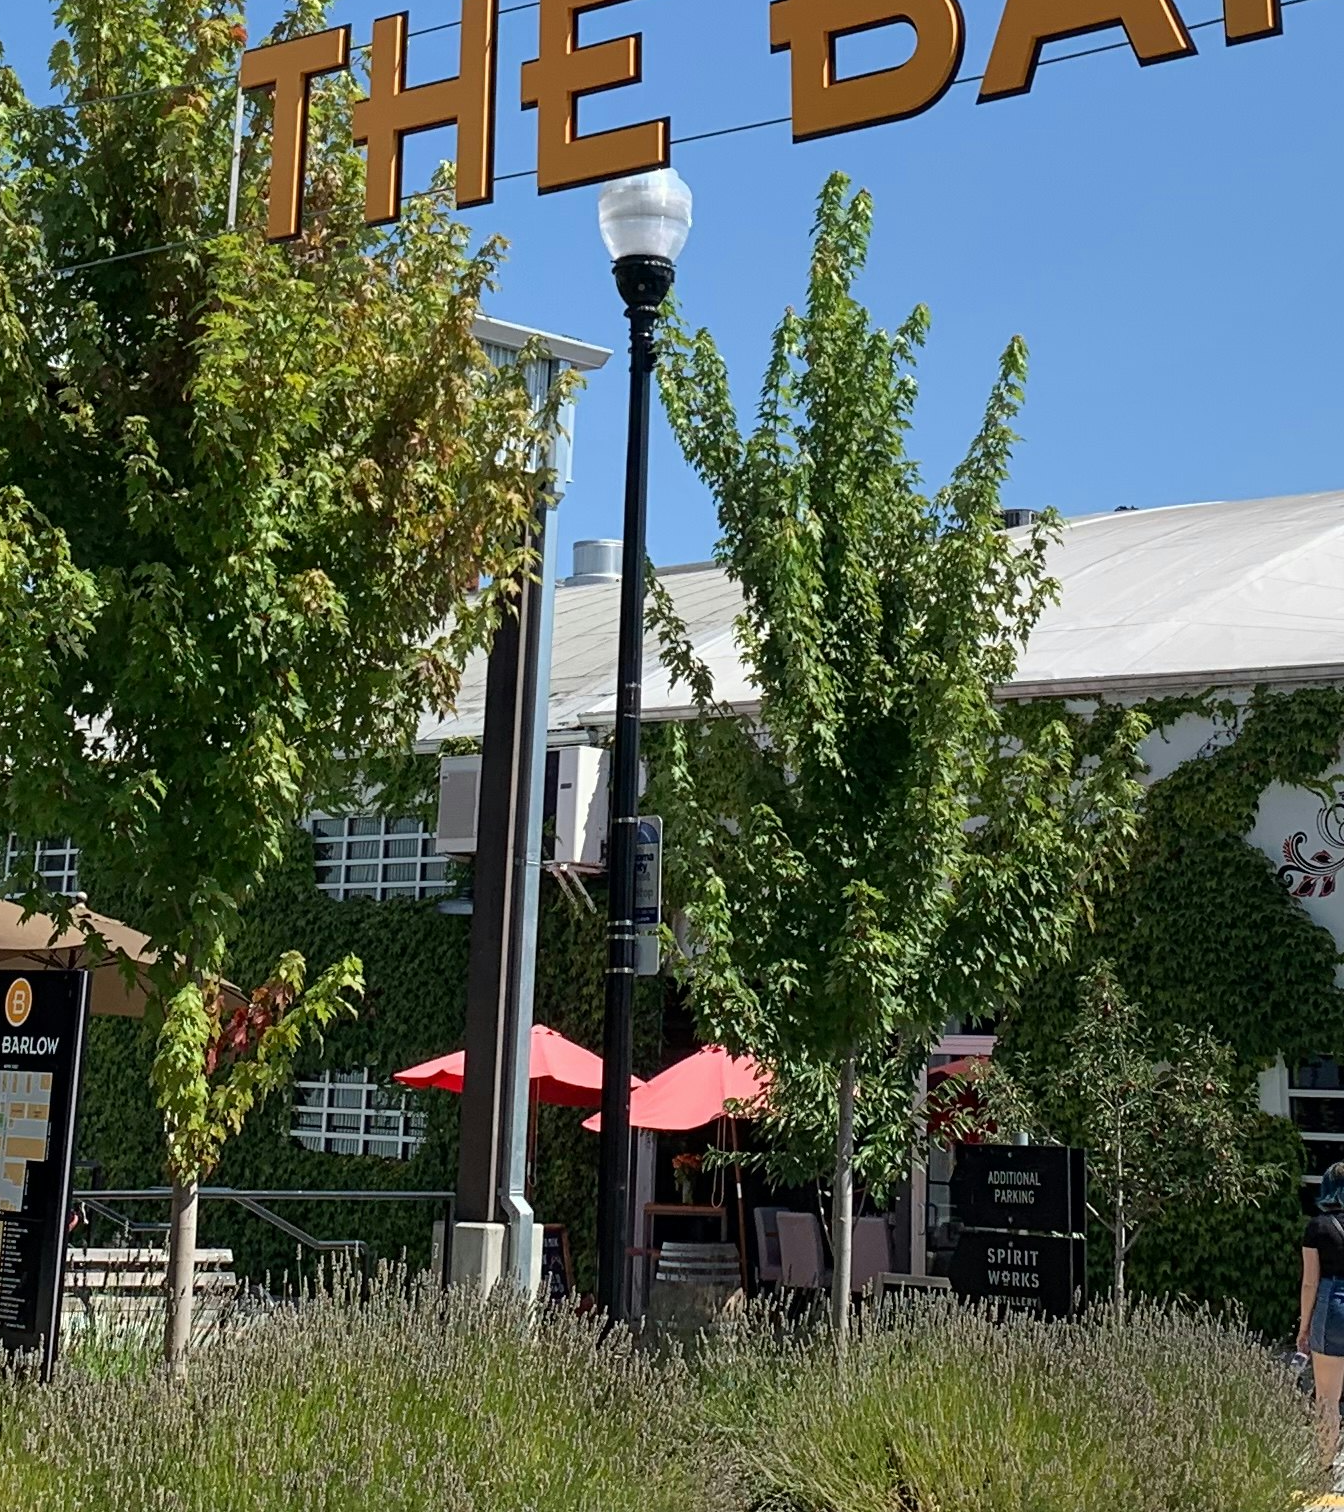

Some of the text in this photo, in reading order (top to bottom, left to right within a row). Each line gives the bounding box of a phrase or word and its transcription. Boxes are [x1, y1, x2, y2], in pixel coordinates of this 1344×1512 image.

[12, 990, 26, 1015] B
[1, 1035, 60, 1055] BARLOW
[987, 1171, 1041, 1186] ADDITIONAL
[994, 1189, 1035, 1204] PARKING
[987, 1248, 1039, 1266] SPIRIT
